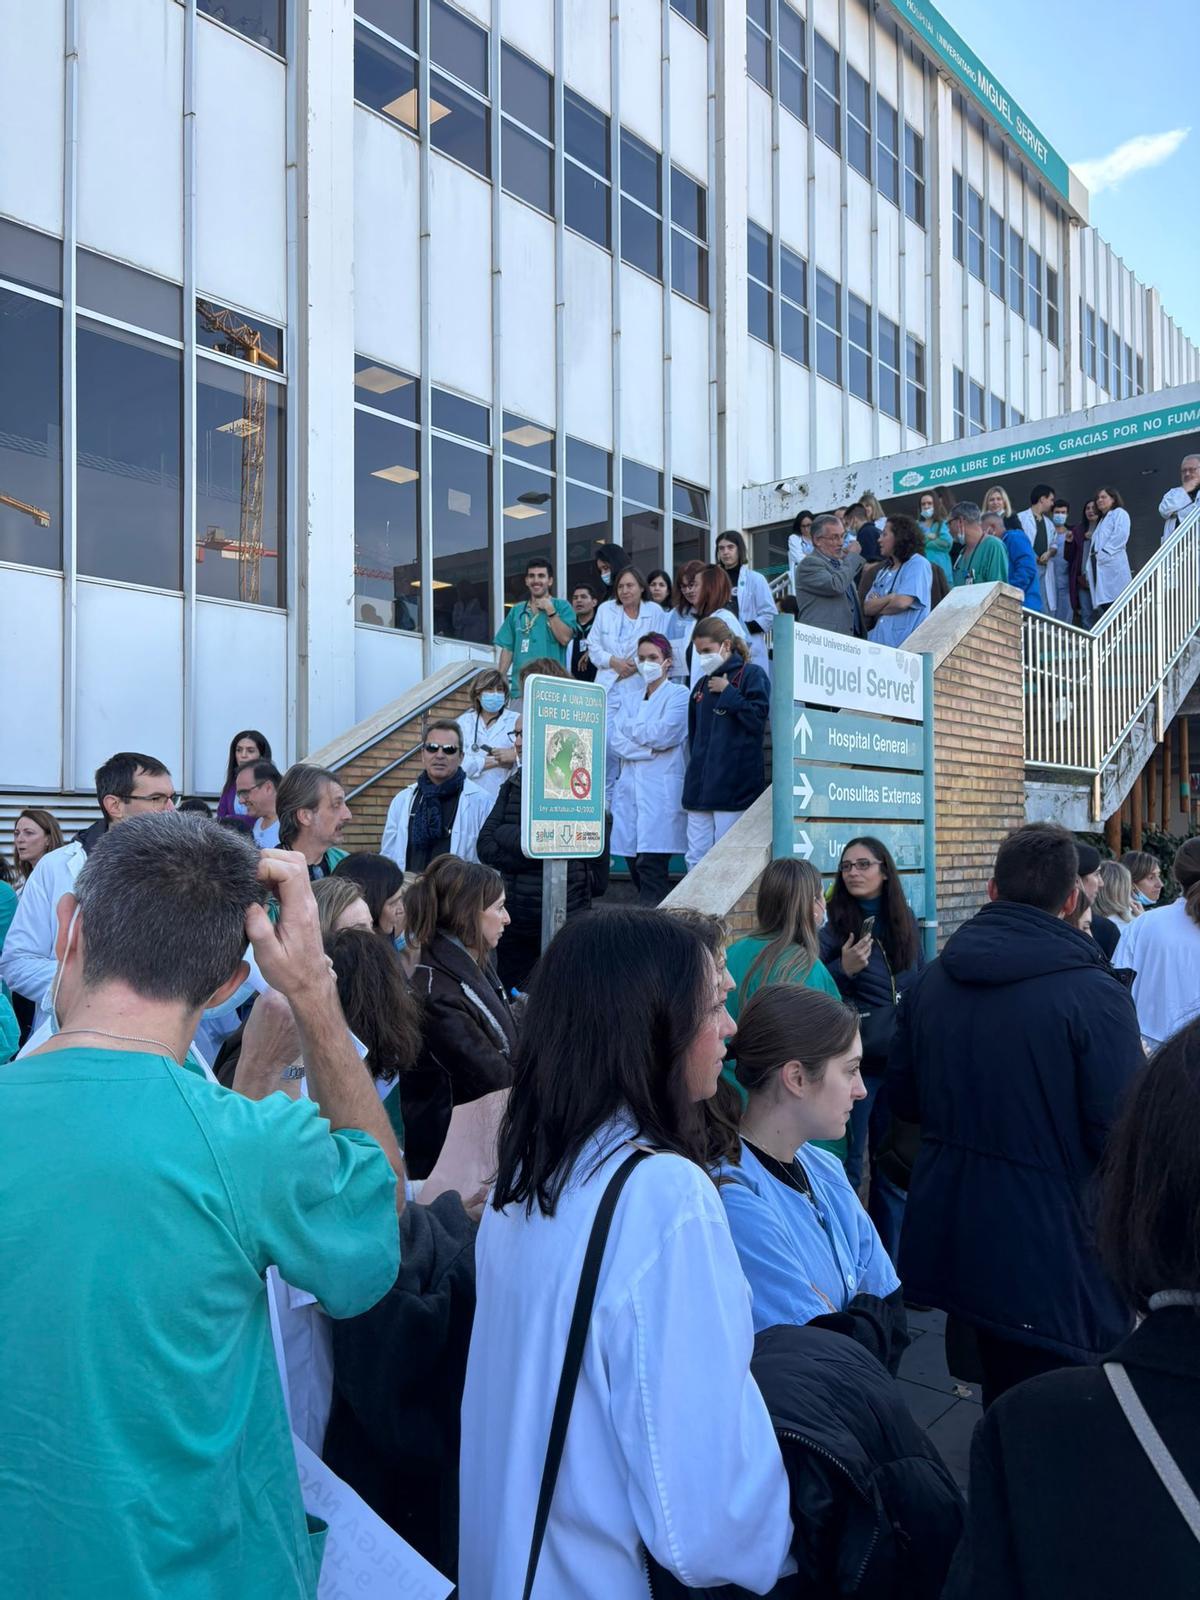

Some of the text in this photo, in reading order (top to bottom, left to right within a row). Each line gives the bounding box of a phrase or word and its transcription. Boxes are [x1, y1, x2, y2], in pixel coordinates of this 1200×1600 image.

[936, 31, 977, 82] UNIVERSITARIO
[977, 69, 1013, 125] MIGUEL
[1016, 116, 1048, 165] SERVET
[929, 464, 958, 480] ZONA
[961, 458, 988, 473] LIBRE
[992, 455, 1006, 467] DE
[1010, 444, 1054, 462] HUMOS.
[1059, 430, 1108, 451] GRACIAS
[1113, 423, 1138, 439] POR
[1143, 418, 1162, 431] NO
[795, 631, 861, 656] Hospital Universitario
[803, 654, 916, 704] Miguel Servet
[535, 690, 560, 703] ACCEDE
[562, 693, 567, 703] A
[538, 706, 599, 724] LIBRE DE HUMOS
[829, 728, 908, 755] Hospital General
[828, 783, 921, 805] Consultas Externas
